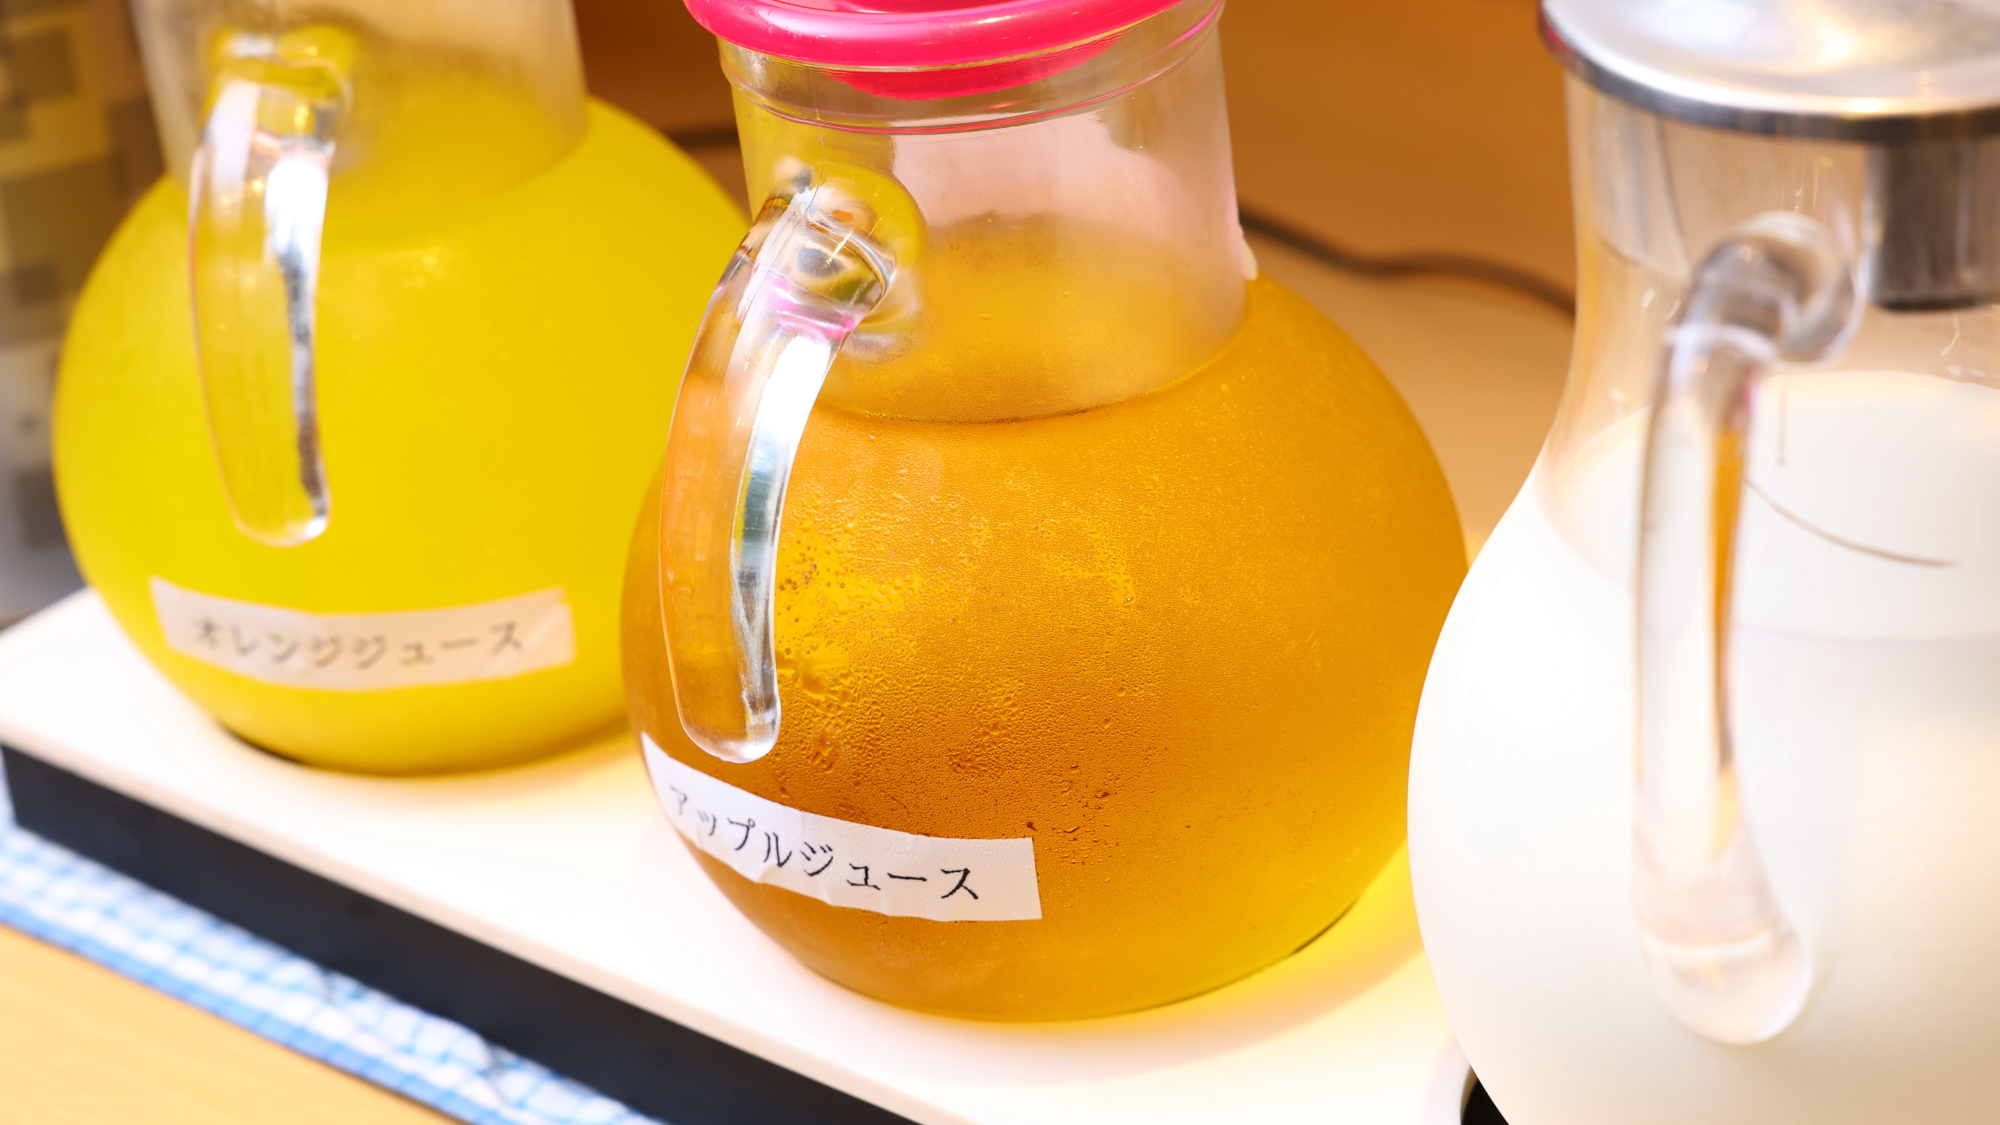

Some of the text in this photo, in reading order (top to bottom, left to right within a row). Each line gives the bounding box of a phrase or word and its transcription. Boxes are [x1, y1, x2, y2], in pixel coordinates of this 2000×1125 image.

[194, 617, 525, 670] オレンジジュース
[669, 783, 979, 900] アップルジュース
